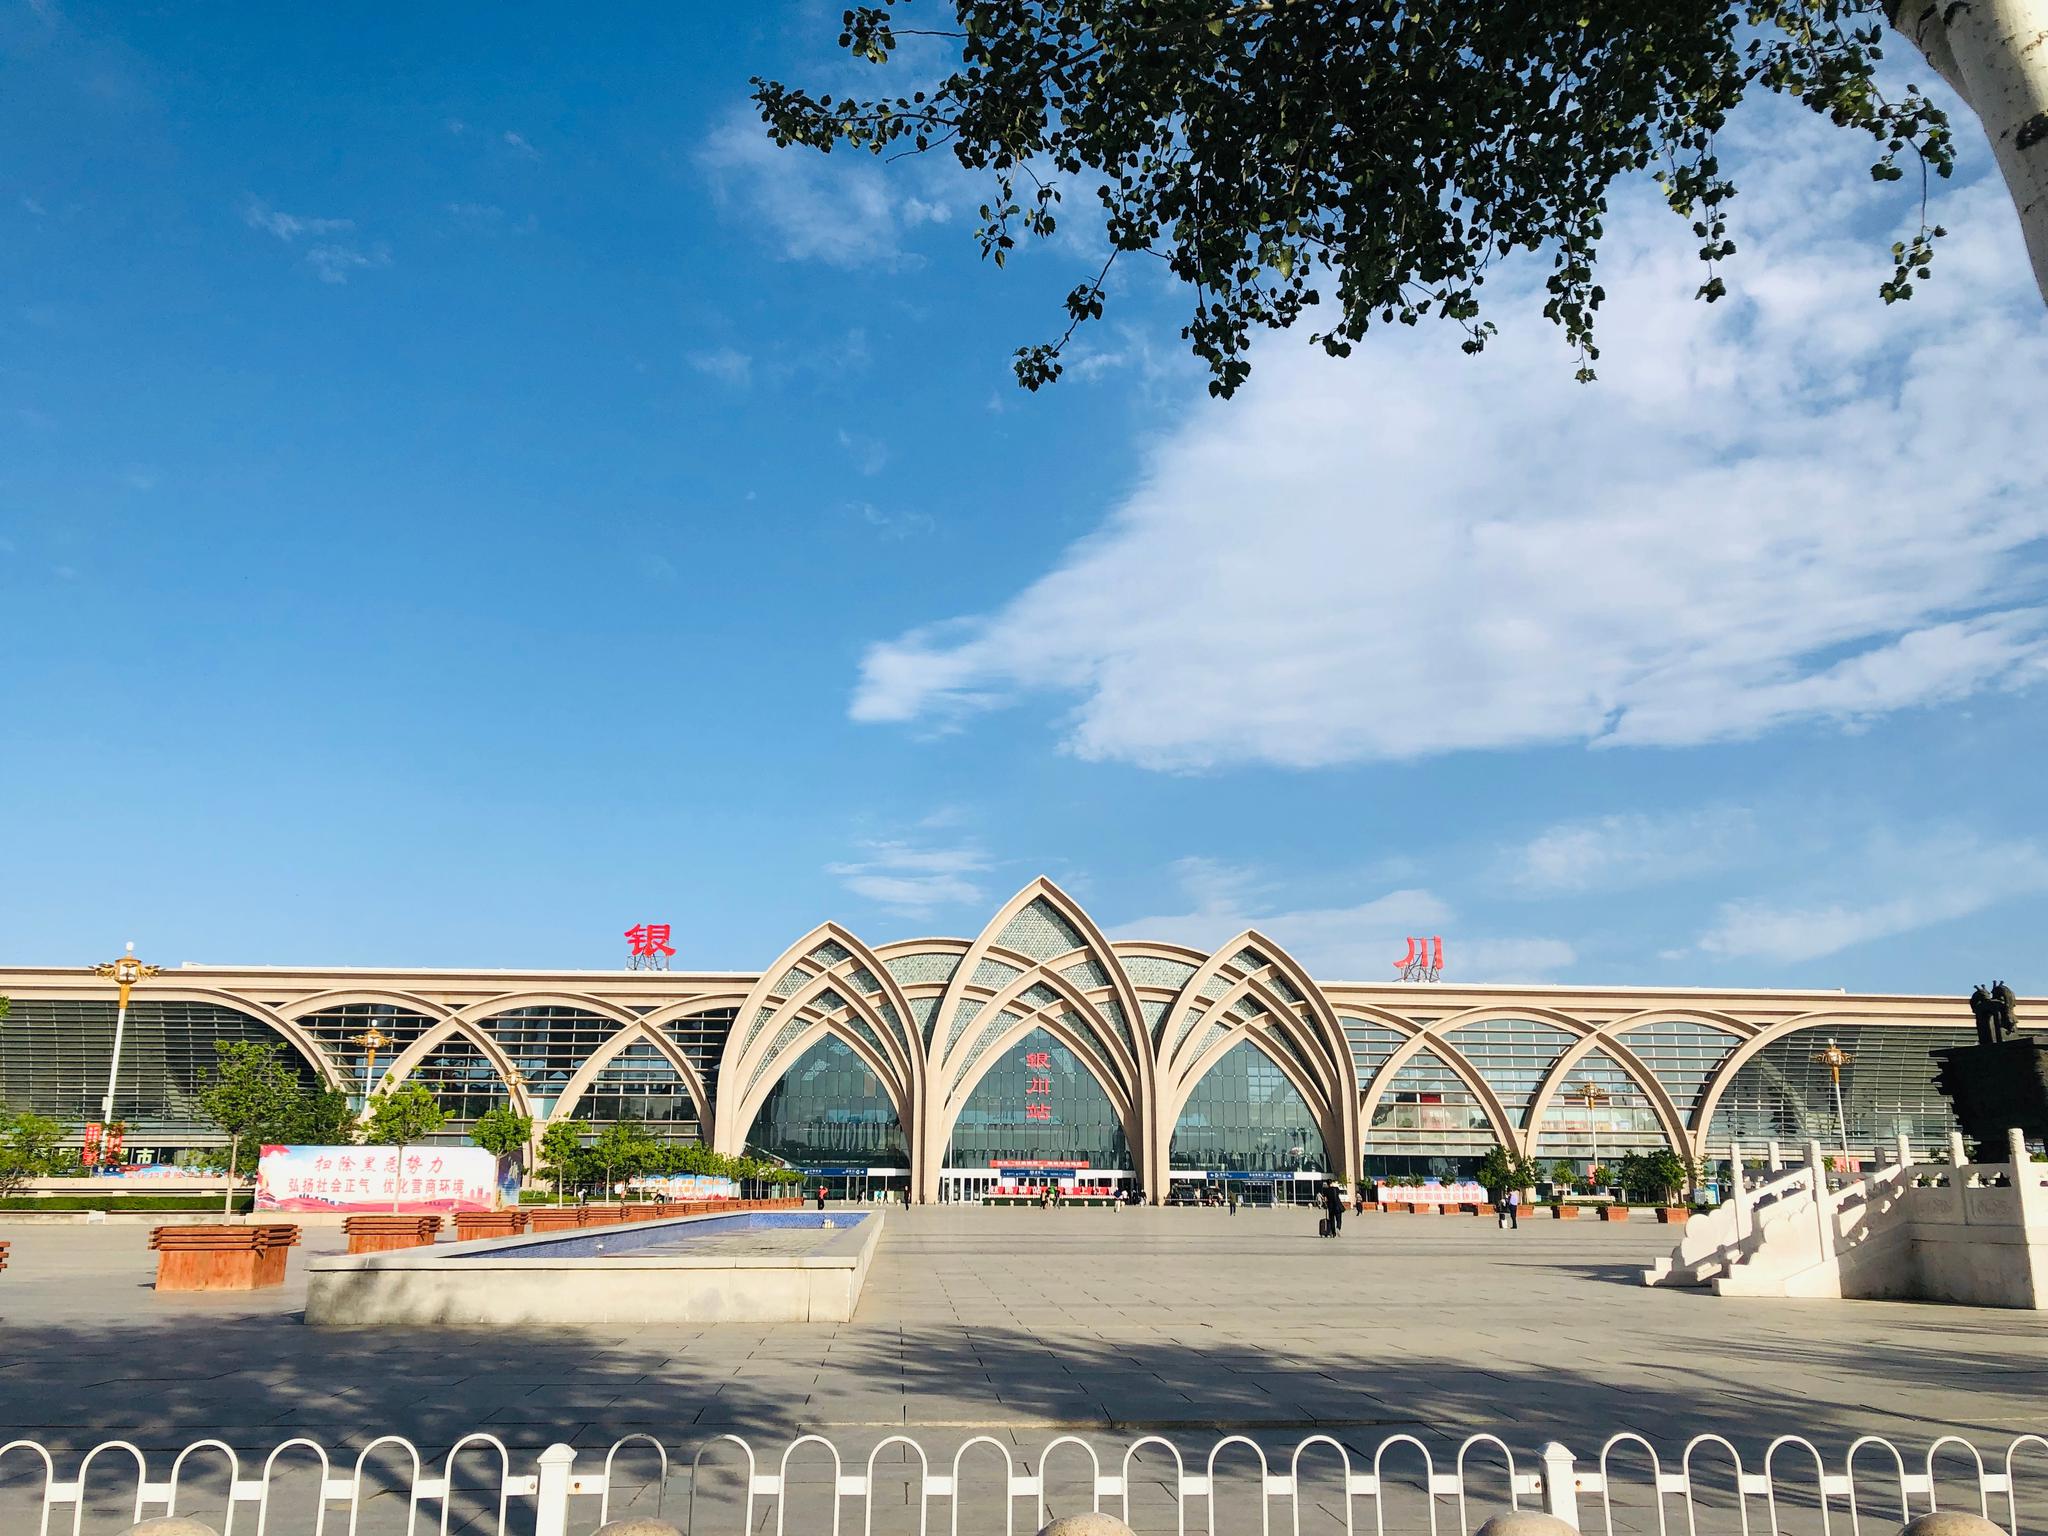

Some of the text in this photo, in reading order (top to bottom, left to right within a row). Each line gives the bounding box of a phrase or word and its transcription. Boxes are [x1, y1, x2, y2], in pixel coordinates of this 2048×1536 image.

[624, 924, 1443, 970] 银 川
[315, 1155, 444, 1174] 扫除黑恶势力
[288, 1178, 371, 1194] 弘扬社会正气
